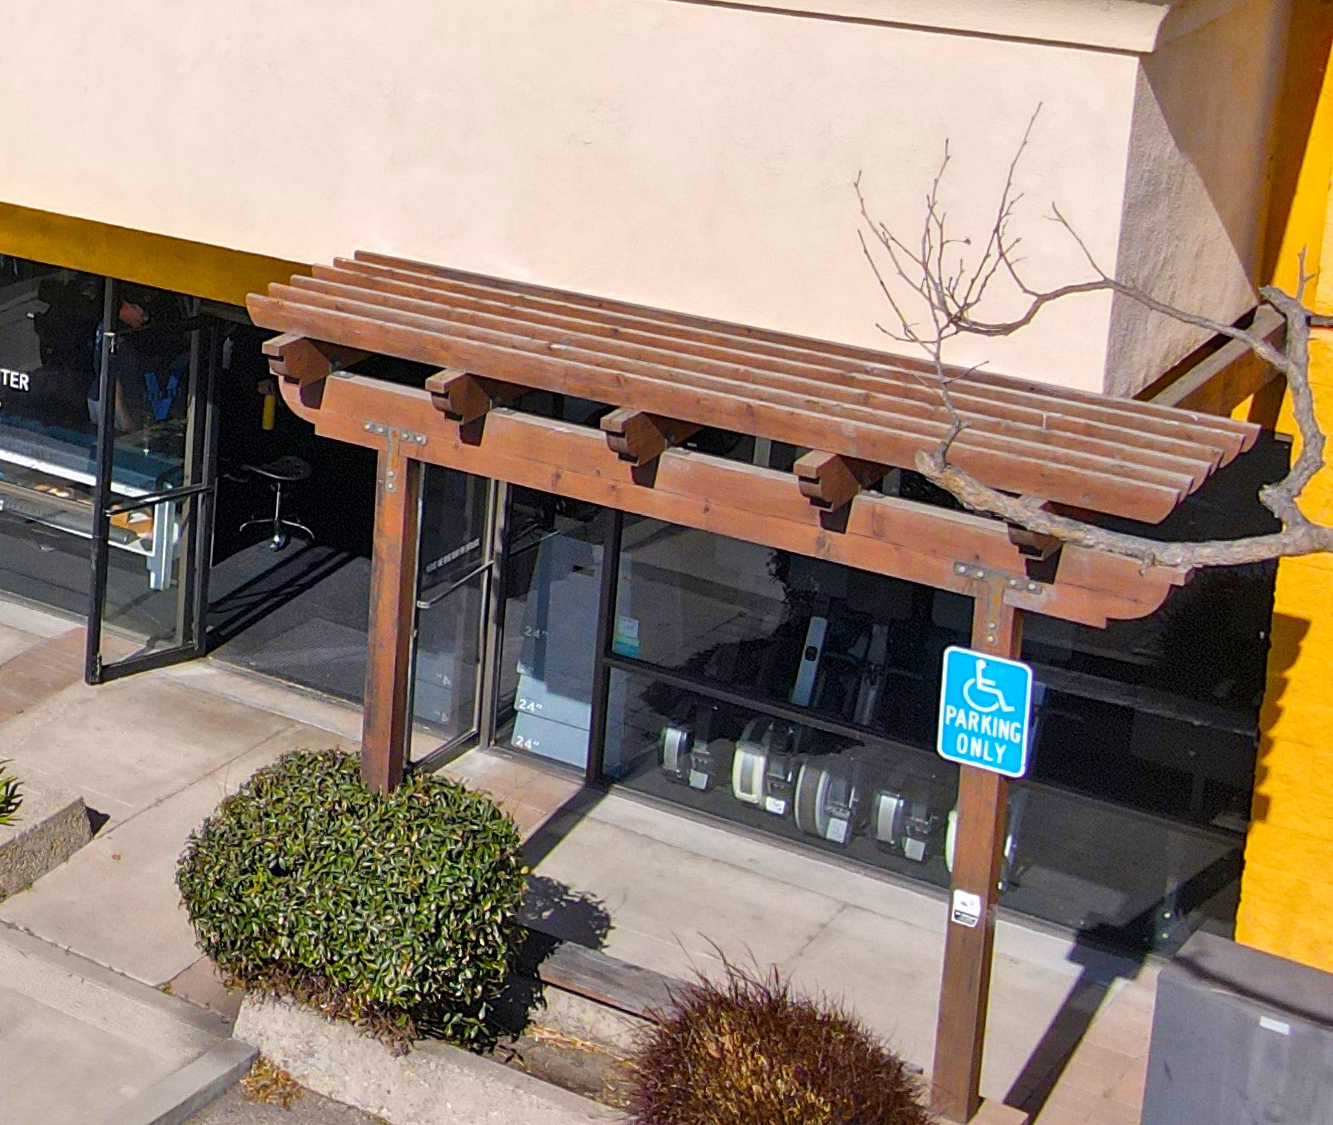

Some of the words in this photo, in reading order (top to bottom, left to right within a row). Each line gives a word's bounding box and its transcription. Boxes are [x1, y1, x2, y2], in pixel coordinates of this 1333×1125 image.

[518, 698, 543, 712] 24"
[945, 704, 1022, 744] PARKING
[515, 735, 540, 751] 24"
[956, 733, 1007, 764] ONLY
